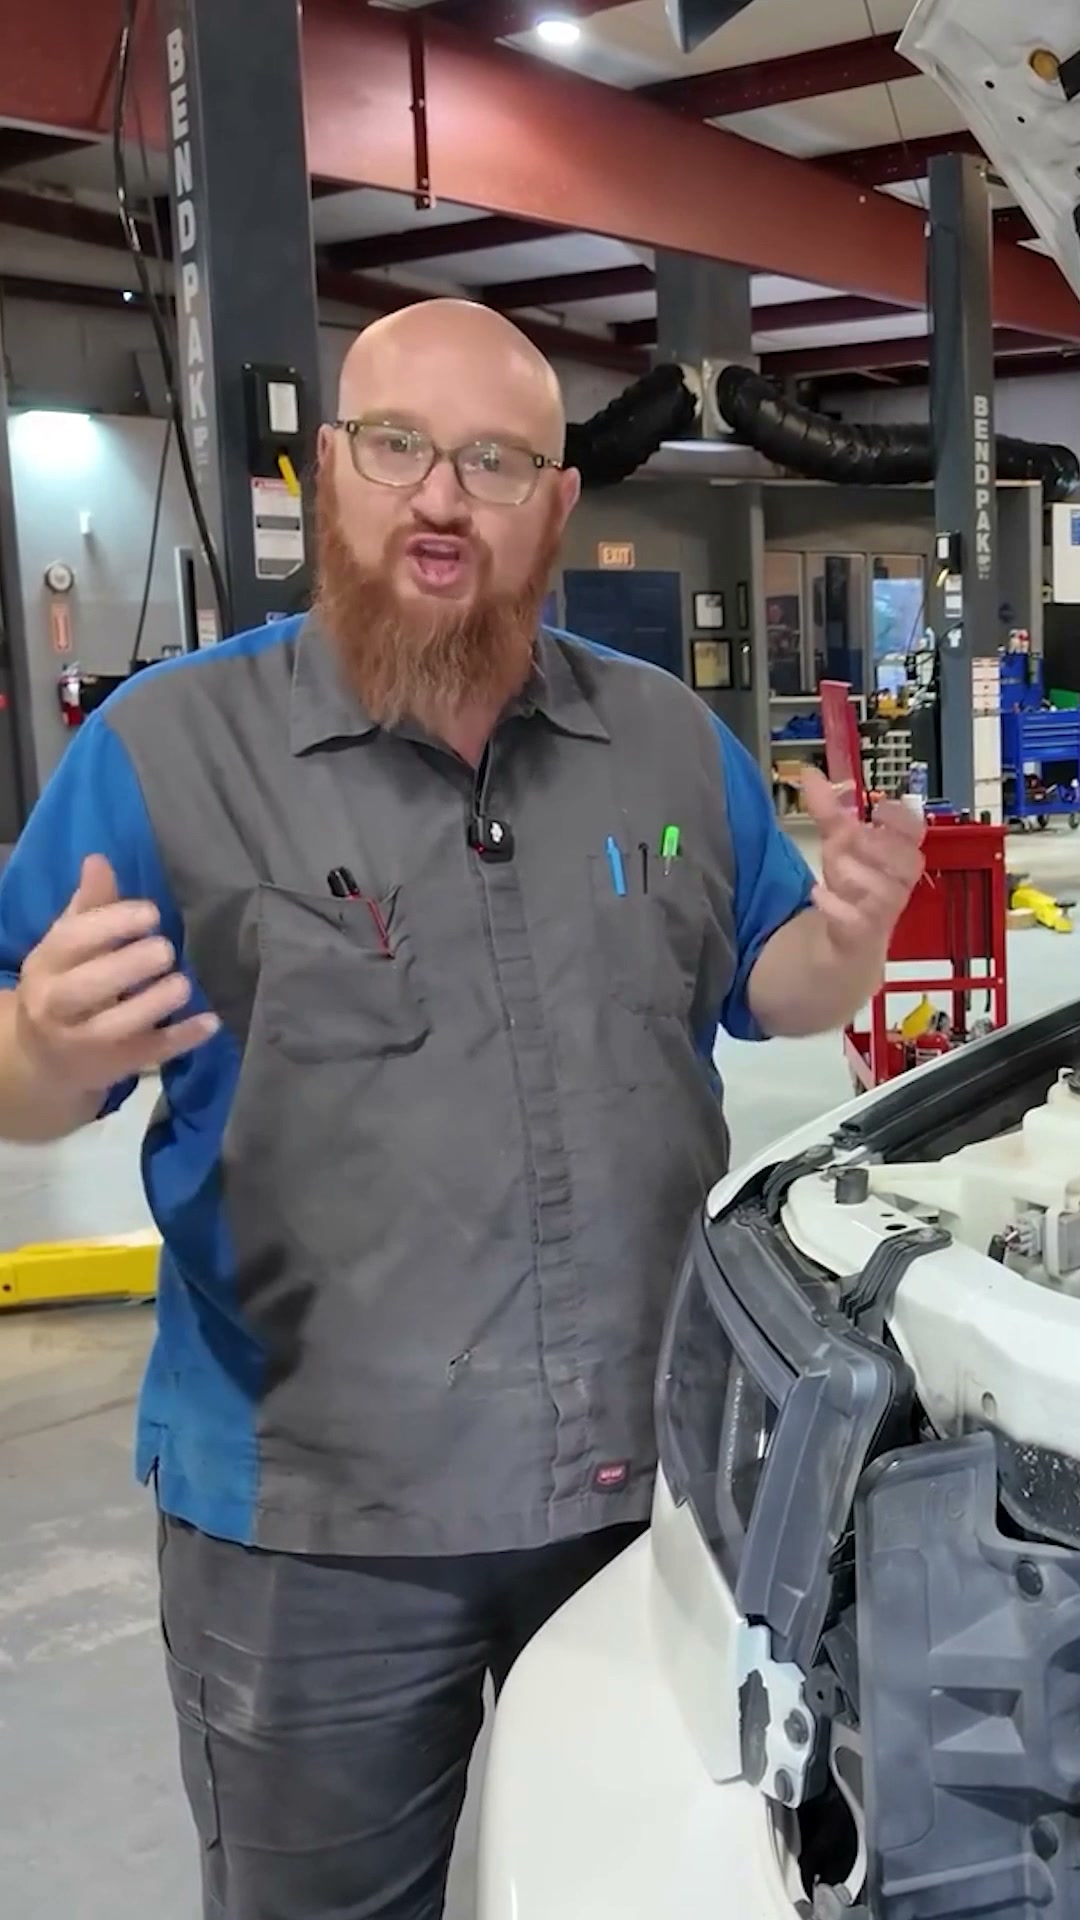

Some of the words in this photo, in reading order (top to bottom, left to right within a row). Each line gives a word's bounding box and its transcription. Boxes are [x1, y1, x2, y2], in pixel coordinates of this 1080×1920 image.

[166, 27, 207, 419] BENDPAK
[973, 395, 991, 553] BENDPAK
[603, 547, 631, 565] EXIT
